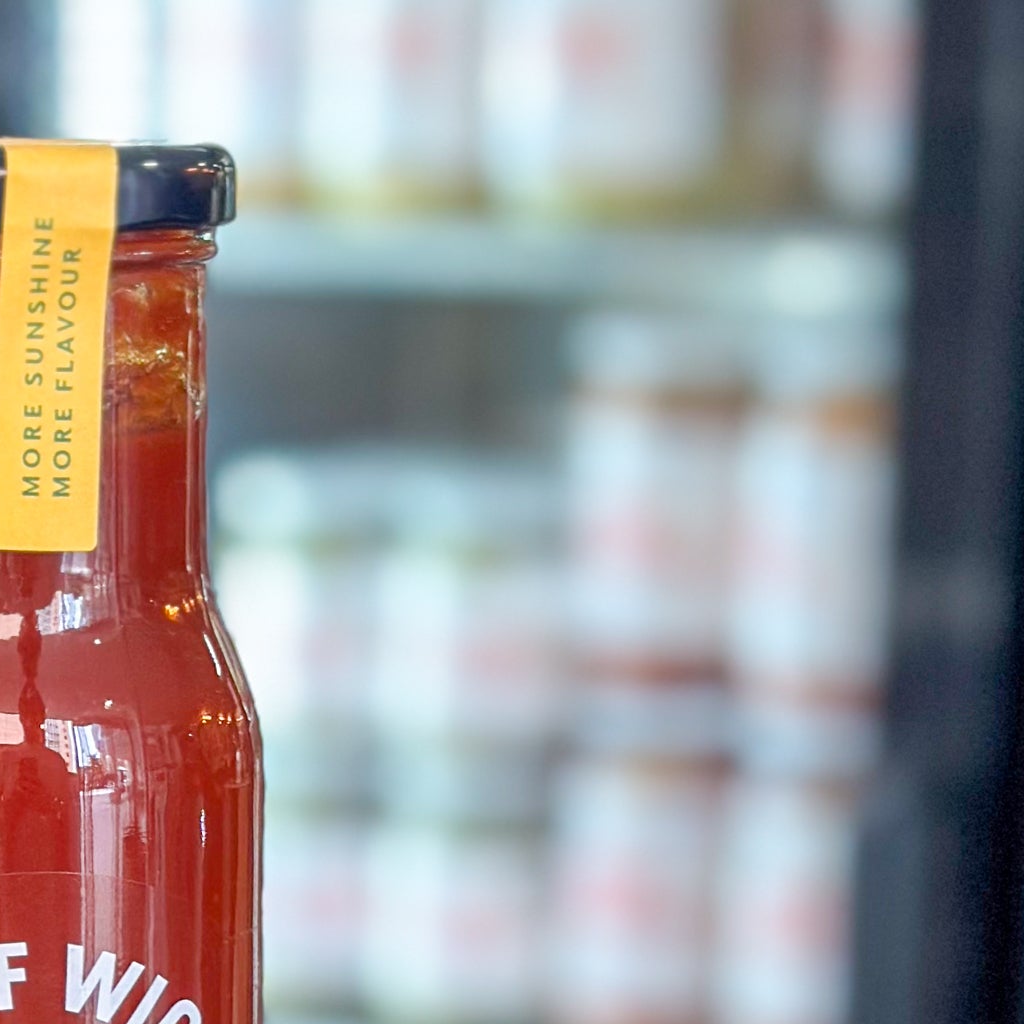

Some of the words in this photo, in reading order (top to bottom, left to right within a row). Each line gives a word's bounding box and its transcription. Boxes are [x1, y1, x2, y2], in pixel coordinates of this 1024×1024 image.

[24, 216, 54, 386] SUNSHINE
[55, 247, 82, 391] FLAVOUR
[22, 404, 43, 497] MORE
[52, 407, 73, 498] MORE
